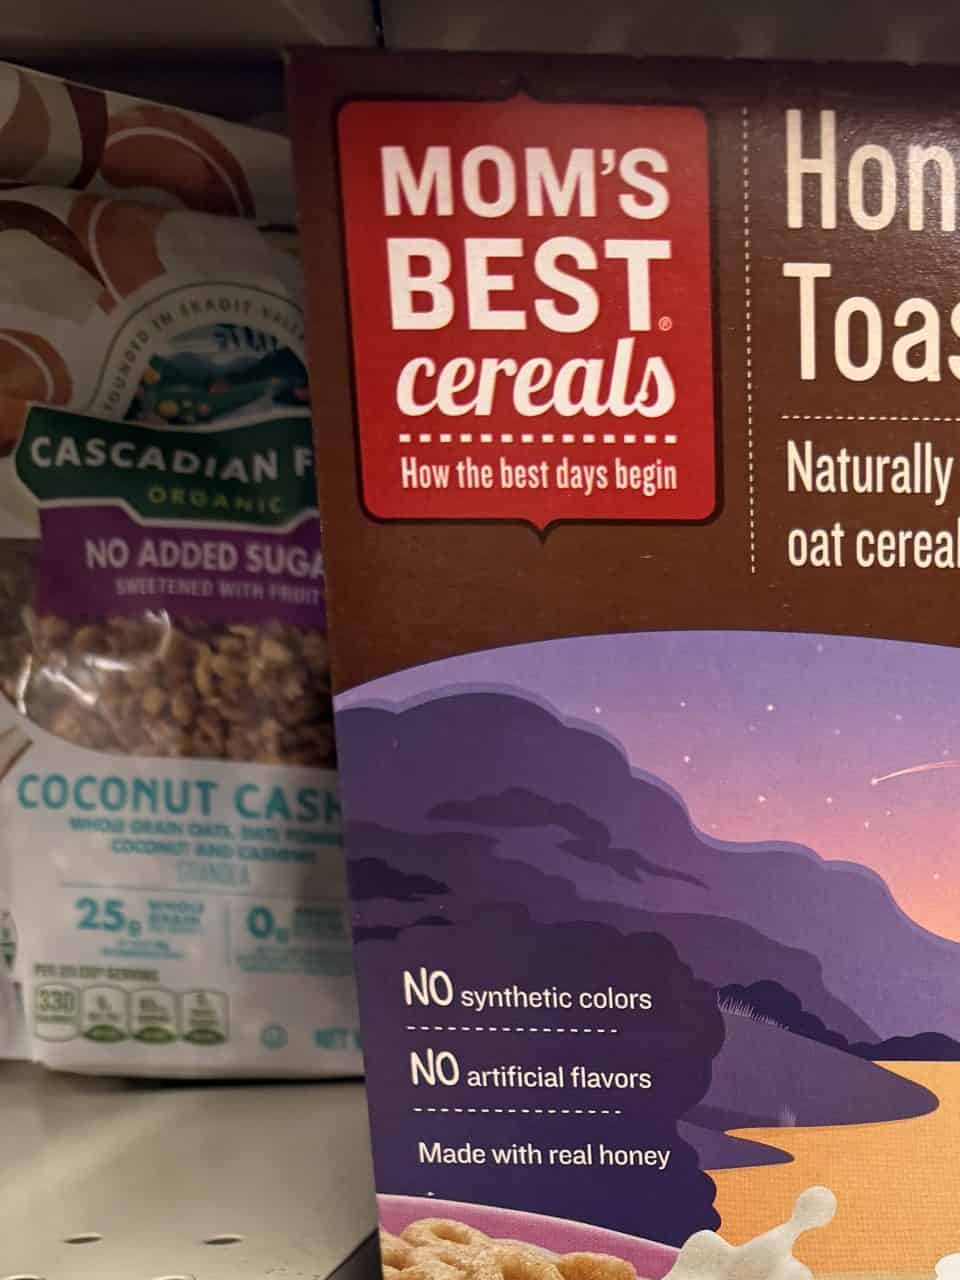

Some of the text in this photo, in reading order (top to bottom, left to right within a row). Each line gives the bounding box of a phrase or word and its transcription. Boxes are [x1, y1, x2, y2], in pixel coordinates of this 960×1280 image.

[380, 144, 670, 220] MOM'S
[396, 337, 676, 418] cereals
[31, 436, 278, 482] CASCADIAN
[401, 456, 678, 497] How the best days begin
[786, 440, 953, 505] Naturally
[147, 484, 282, 515] ORGANIC
[85, 538, 128, 569] NO
[138, 539, 238, 572] ADDED
[787, 522, 844, 569] oat
[17, 774, 218, 817] COCONUT
[403, 966, 652, 1012] NO synthetic colors
[410, 1047, 652, 1089] NO artificial flavors
[418, 1142, 671, 1170] Made with real honey
